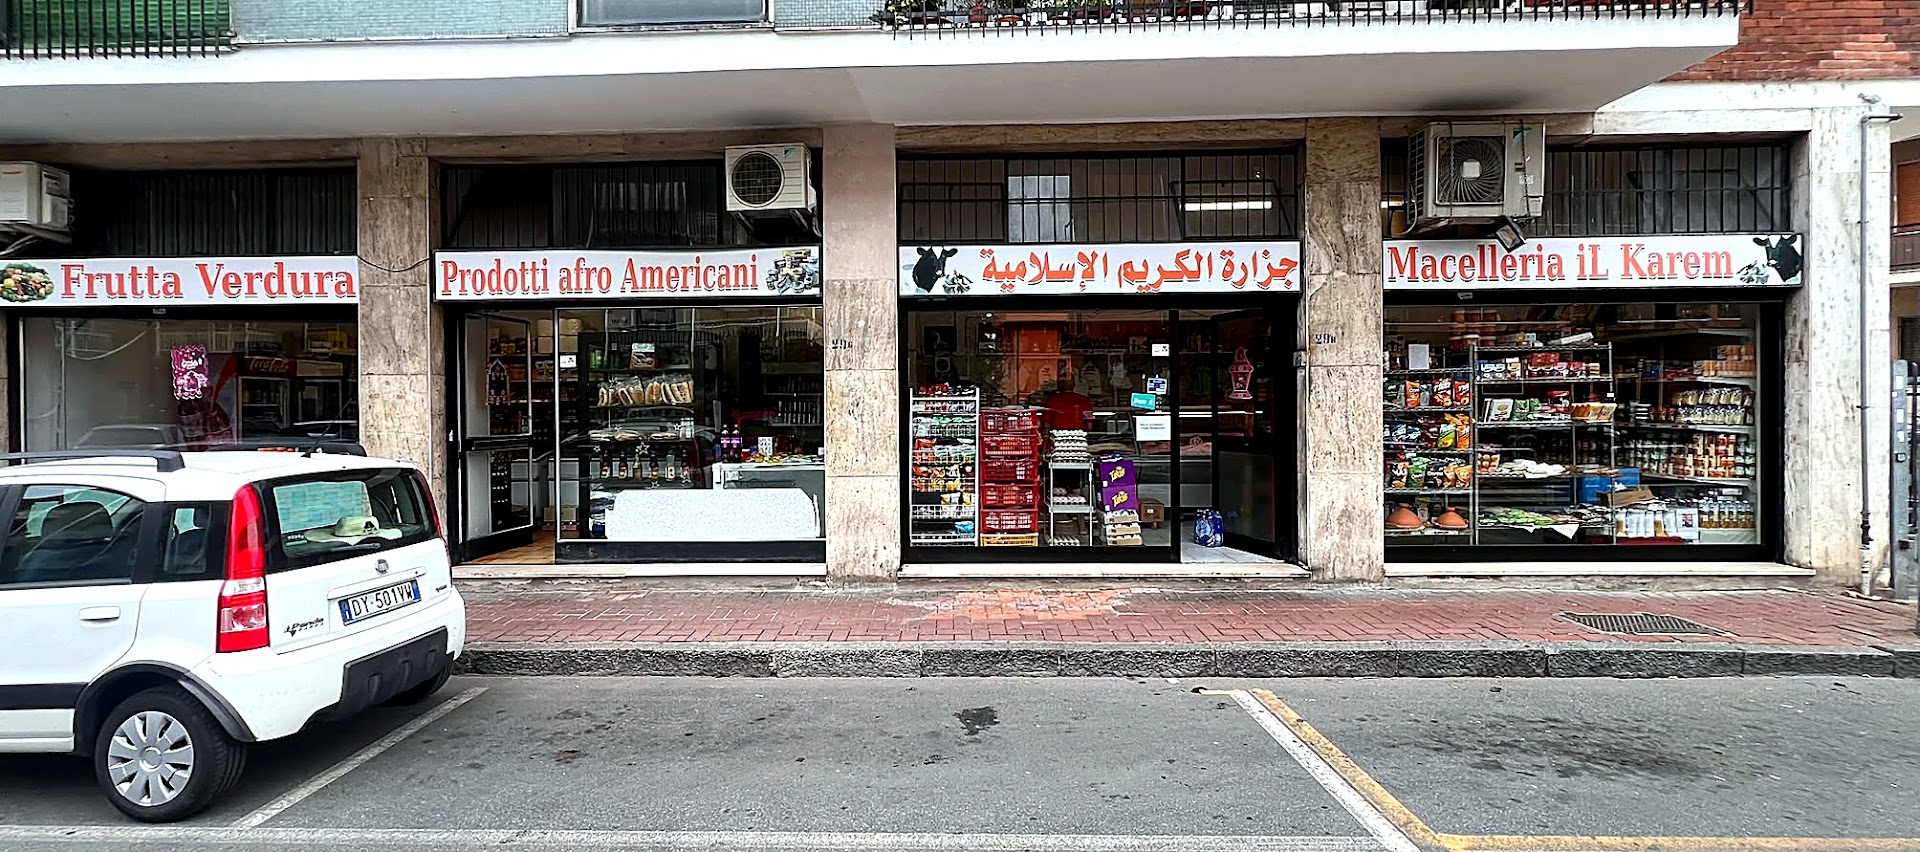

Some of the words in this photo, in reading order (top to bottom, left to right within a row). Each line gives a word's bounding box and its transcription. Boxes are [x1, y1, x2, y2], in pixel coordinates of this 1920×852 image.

[61, 263, 184, 299] Frutta
[195, 261, 357, 299] Verdura
[441, 257, 550, 295] Prodotti
[558, 256, 612, 294] afro
[620, 253, 760, 294] Americani
[980, 248, 1110, 293] الإسلامية
[1117, 249, 1214, 293] الكريم
[1221, 249, 1299, 290] جزارة
[1388, 244, 1566, 283] Macelleria
[1620, 243, 1735, 279] Karem
